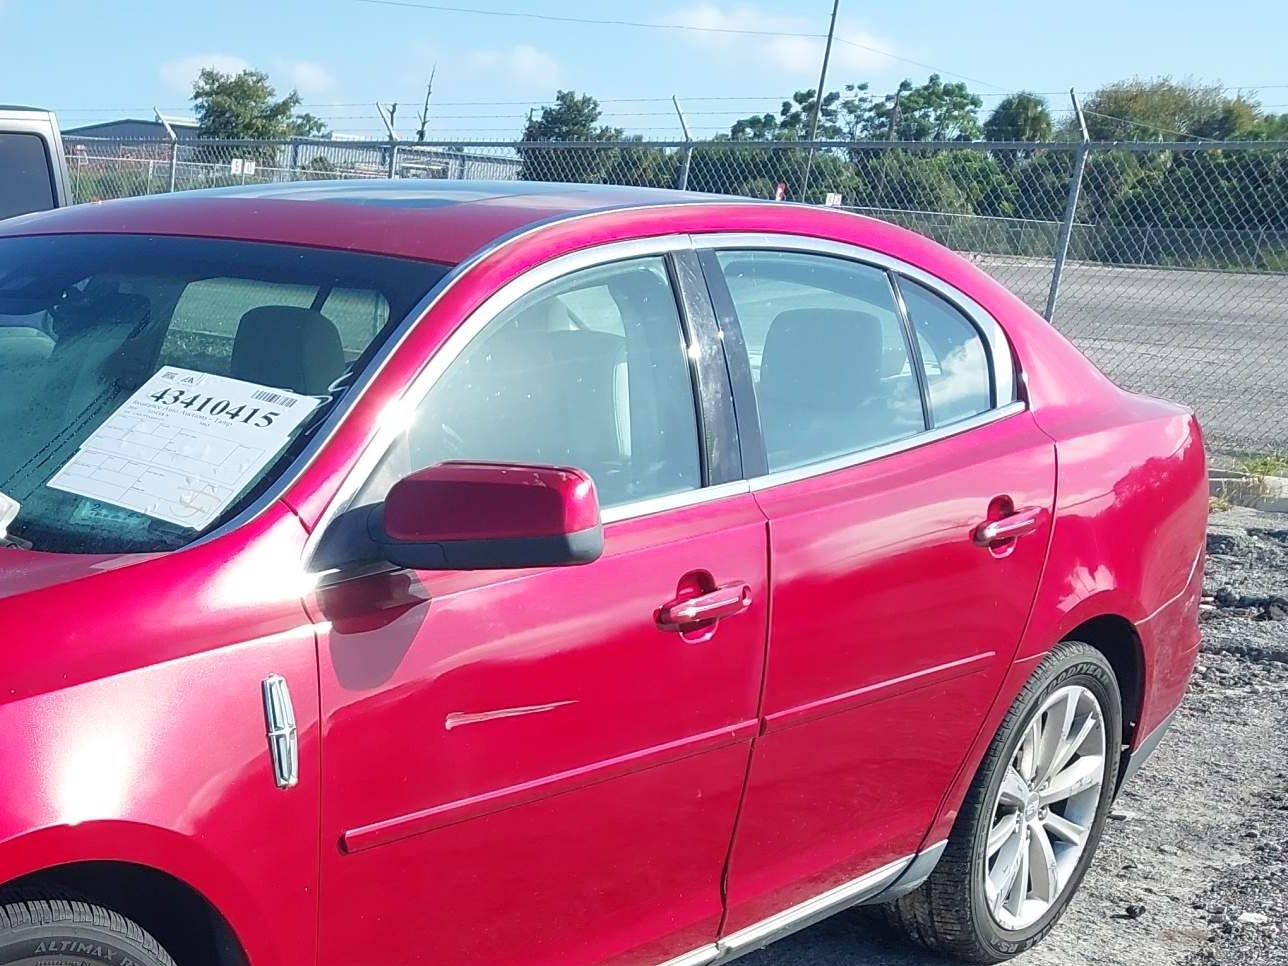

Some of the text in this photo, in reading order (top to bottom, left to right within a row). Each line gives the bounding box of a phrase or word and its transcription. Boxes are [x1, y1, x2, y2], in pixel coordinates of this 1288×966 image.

[150, 387, 280, 428] 43410415
[1037, 663, 1110, 705] GOODYEAR
[35, 940, 117, 961] ALTIMAX
